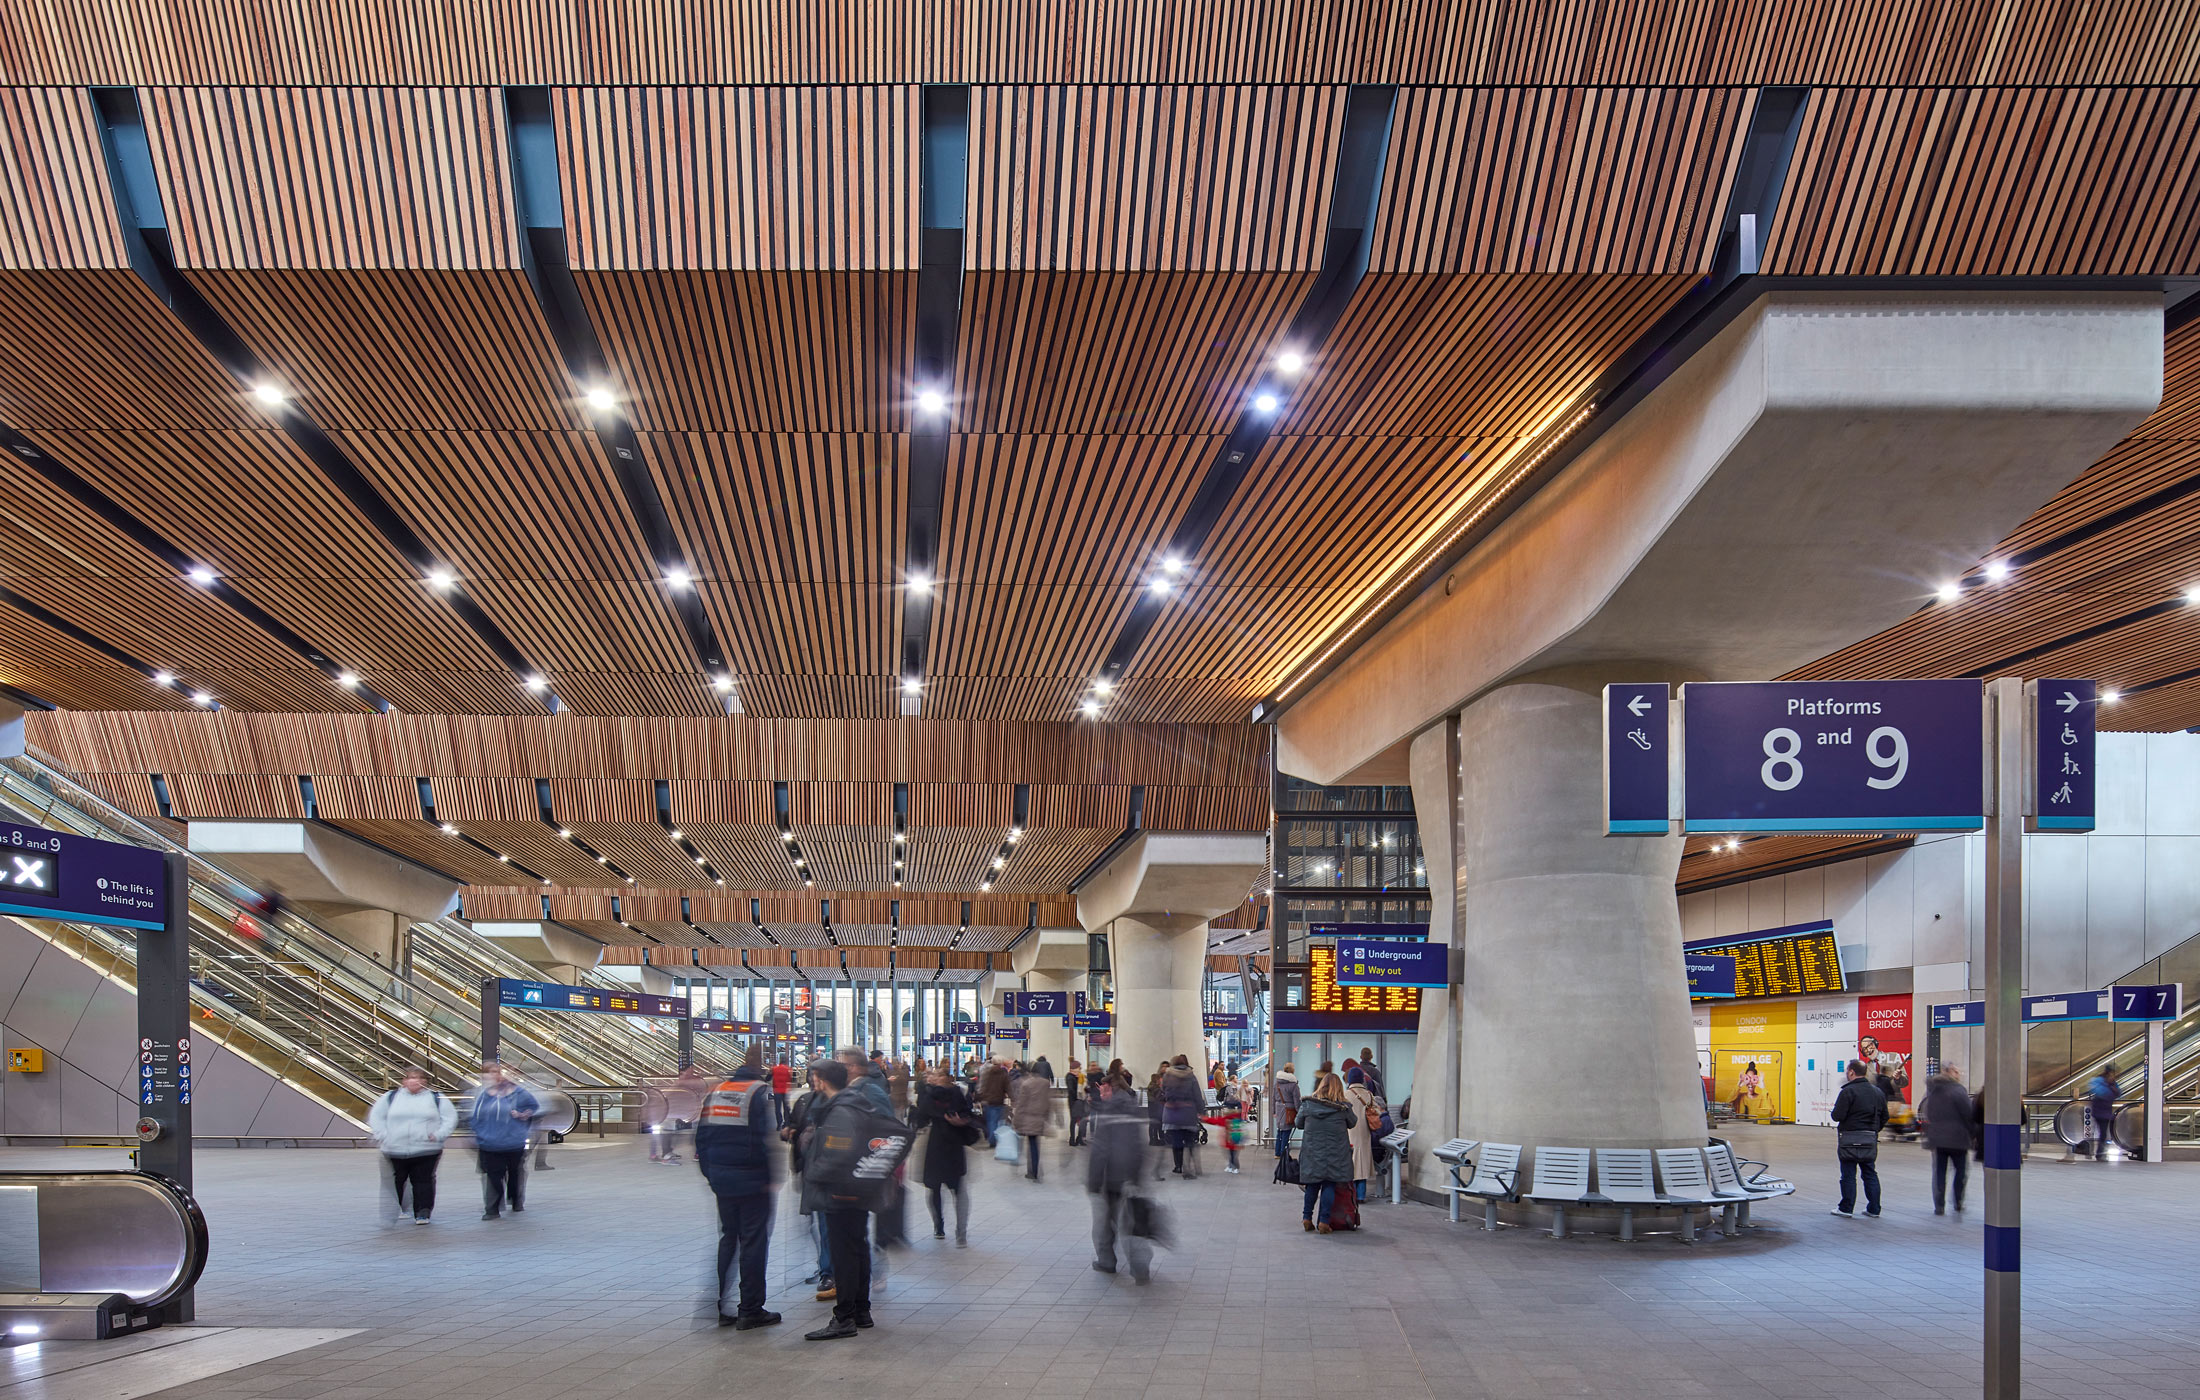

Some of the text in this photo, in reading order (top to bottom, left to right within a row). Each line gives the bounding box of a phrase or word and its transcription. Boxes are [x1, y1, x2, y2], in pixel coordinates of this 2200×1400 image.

[1787, 698, 1881, 715] Platforms
[1760, 726, 1909, 791] 8 and 9
[12, 830, 23, 846] 8
[26, 840, 47, 850] and
[50, 838, 60, 852] 9
[111, 880, 154, 896] The lift is
[101, 893, 154, 909] behind you
[1368, 950, 1422, 960] Underground
[1368, 966, 1402, 976] Way out
[1028, 999, 1037, 1010] 6
[1046, 999, 1055, 1010] 7
[2124, 994, 2136, 1010] 7
[2156, 992, 2167, 1010] 7
[1806, 1012, 1848, 1020] LAUNCHING
[1866, 1009, 1907, 1019] LONDON
[1736, 1016, 1768, 1025] LONDON
[1869, 1020, 1904, 1029] BRIDGE
[1738, 1026, 1765, 1034] BRIDGE
[1732, 1054, 1772, 1064] INDULGE
[1879, 1053, 1911, 1064] PLAY
